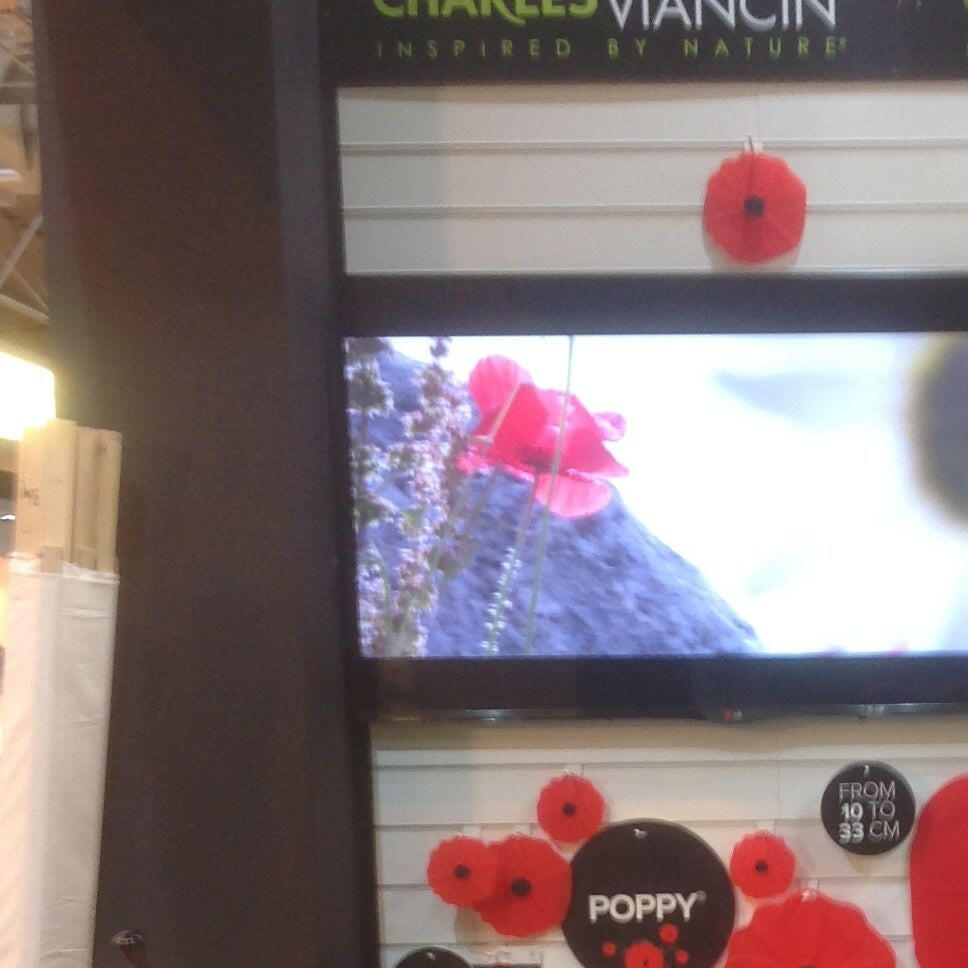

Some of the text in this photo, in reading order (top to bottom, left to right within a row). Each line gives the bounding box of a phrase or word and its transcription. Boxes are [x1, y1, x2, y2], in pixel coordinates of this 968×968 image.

[375, 38, 573, 58] INSPIRED
[606, 37, 648, 57] BY
[839, 781, 896, 800] FROM
[841, 800, 896, 820] 10 TO
[839, 820, 900, 843] 33 CM
